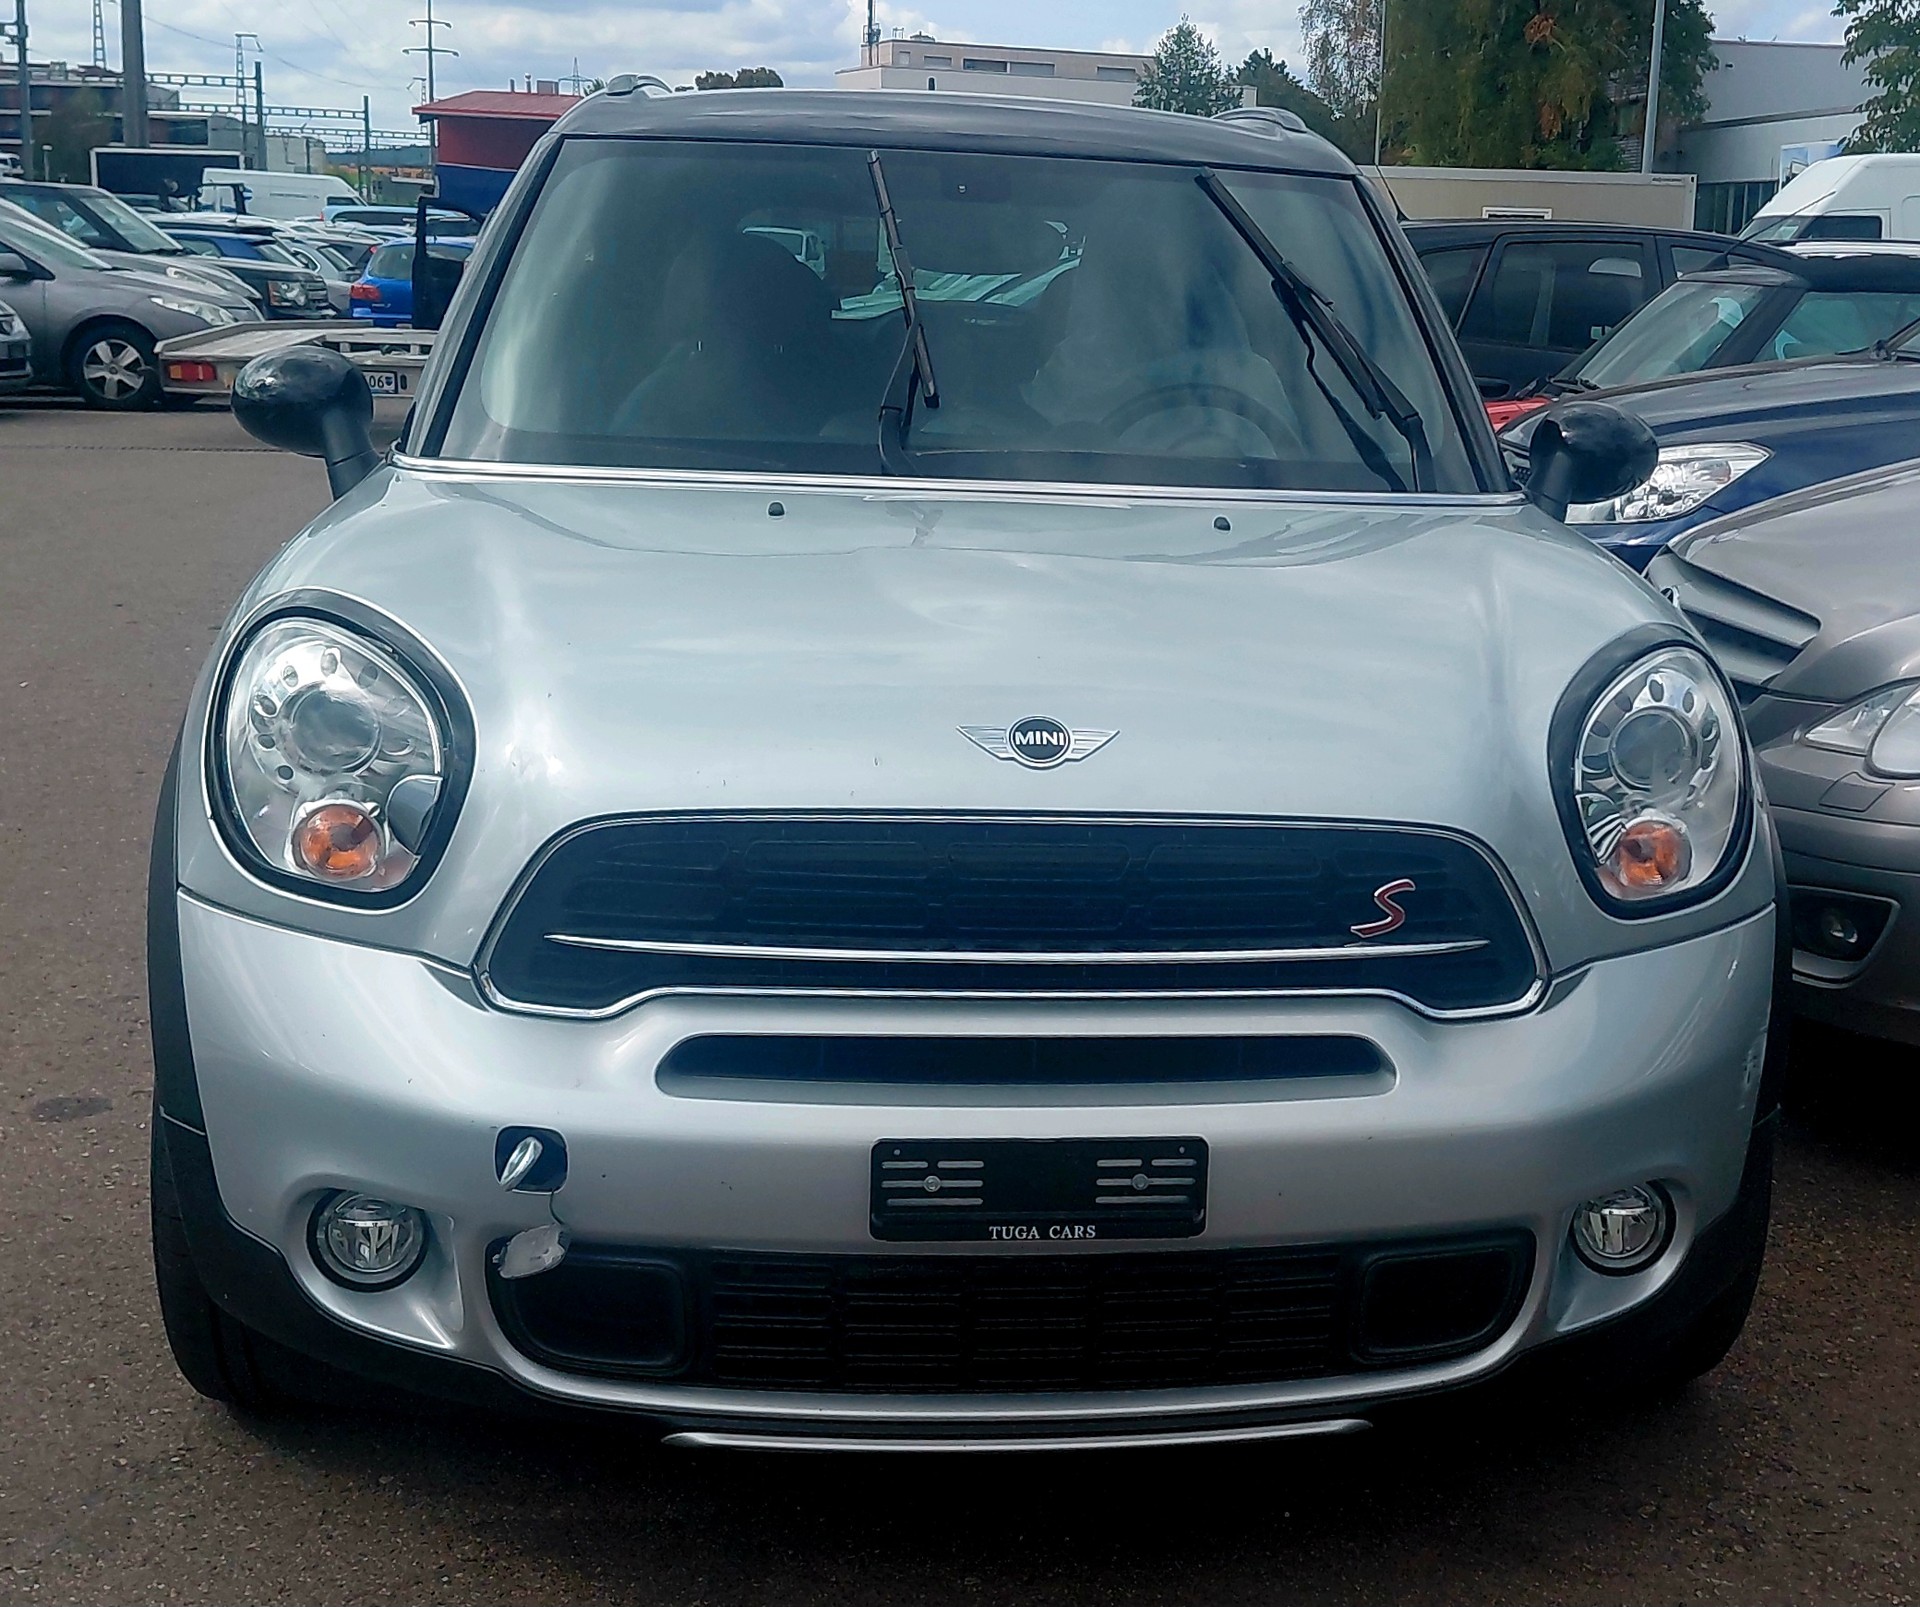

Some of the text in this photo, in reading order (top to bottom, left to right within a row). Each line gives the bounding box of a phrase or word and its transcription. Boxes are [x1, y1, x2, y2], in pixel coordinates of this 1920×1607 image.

[1015, 730, 1065, 746] MINI
[1350, 878, 1416, 939] S
[989, 1225, 1096, 1240] TUGA CARS
